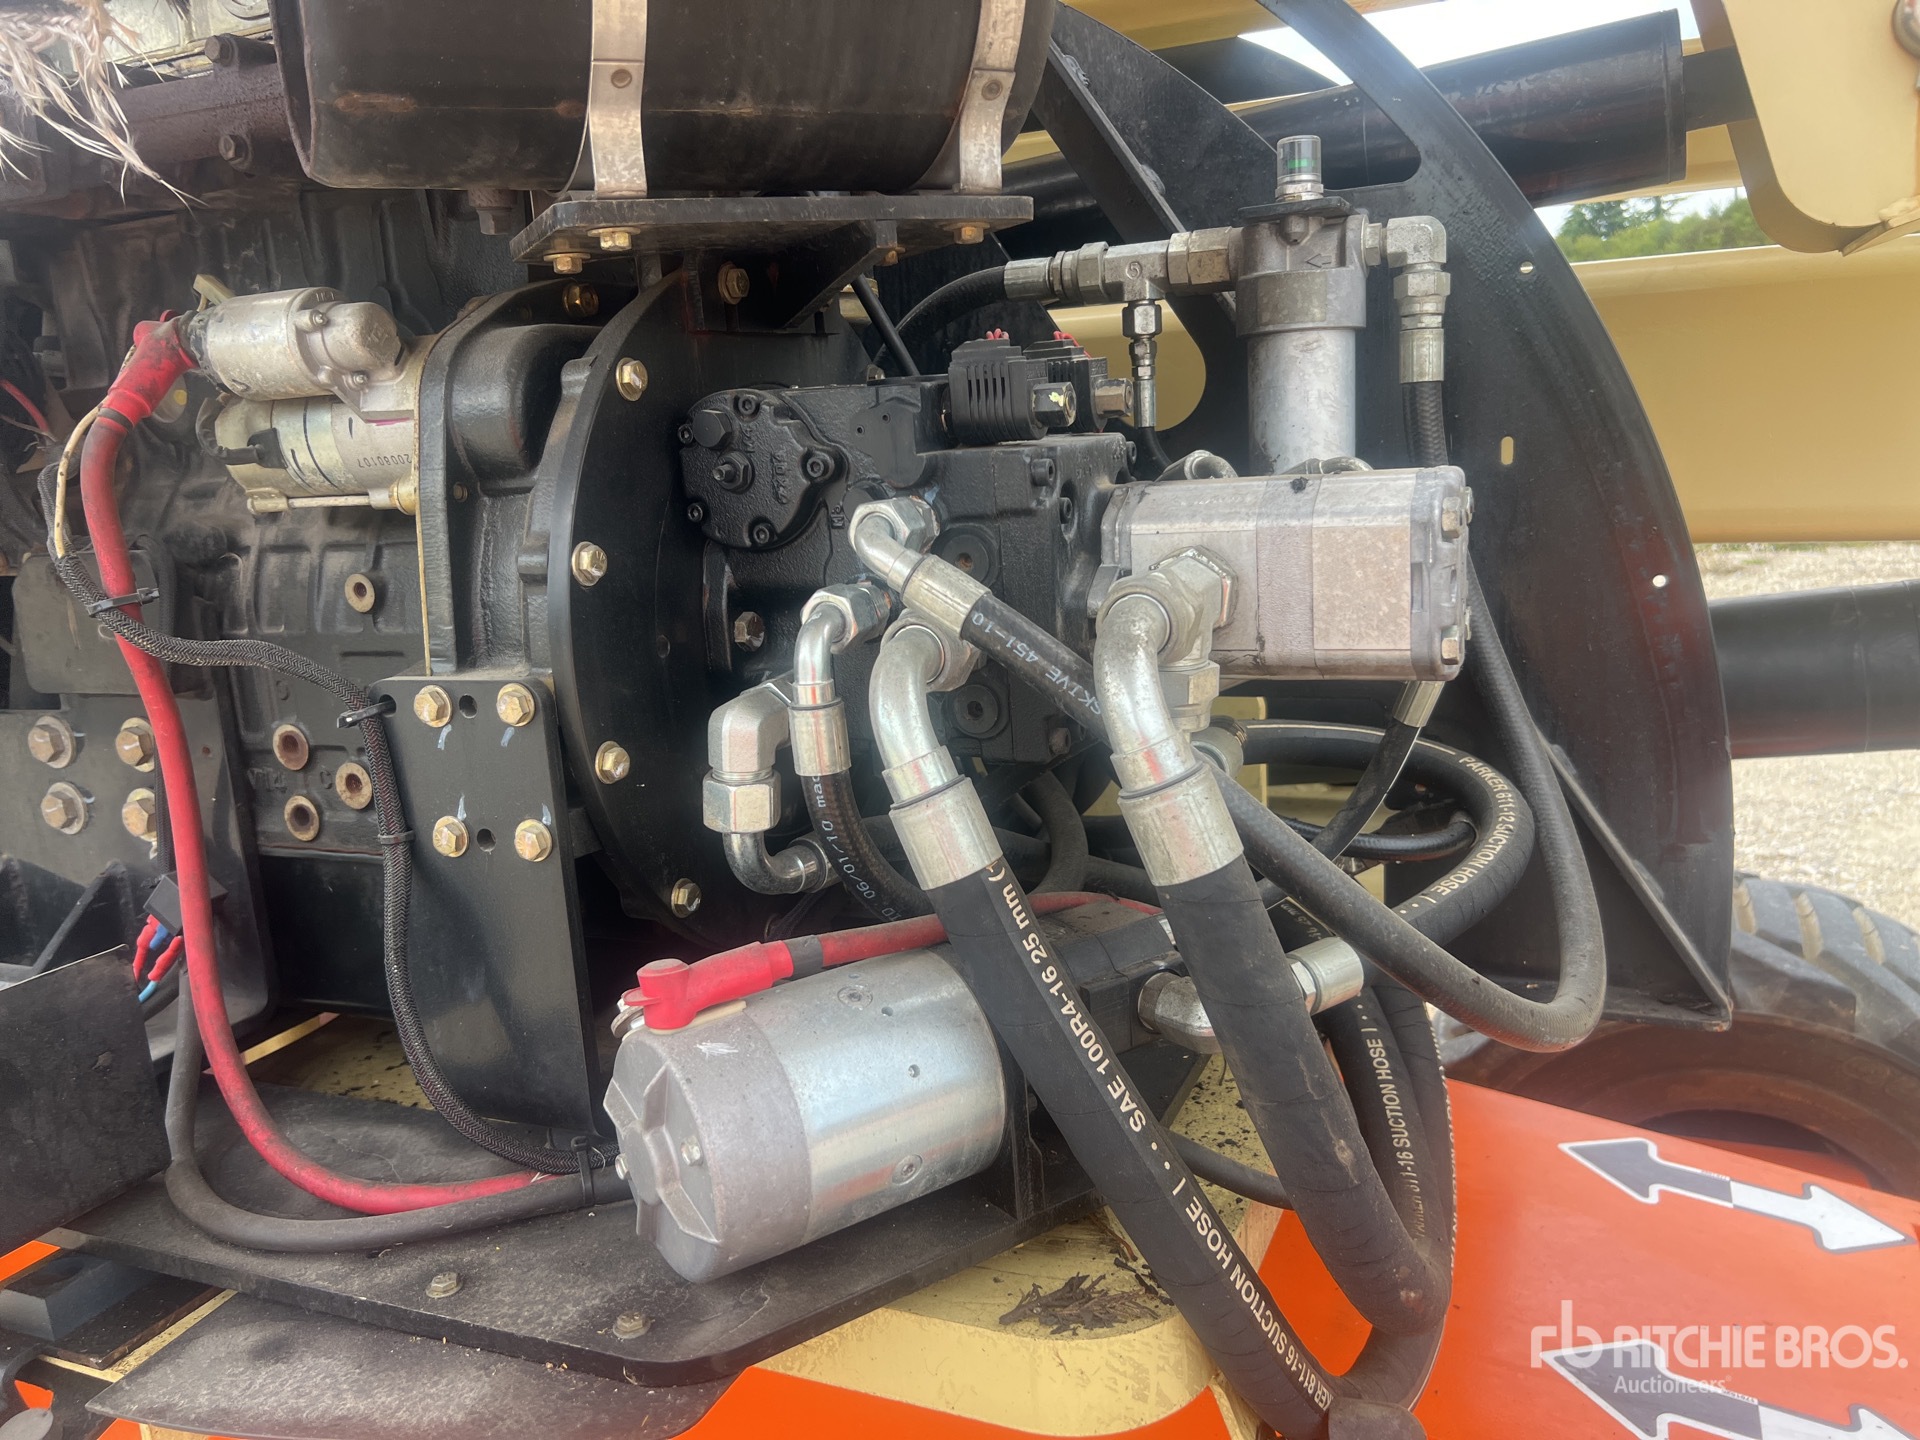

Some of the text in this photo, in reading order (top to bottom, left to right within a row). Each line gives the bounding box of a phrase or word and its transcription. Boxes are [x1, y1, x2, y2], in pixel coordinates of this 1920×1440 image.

[972, 611, 1039, 663] 451-10
[1430, 757, 1516, 896] PARKER 811-12 SUCTION HOSE
[821, 819, 876, 901] 06/01/10
[1002, 883, 1030, 930] mm
[1022, 932, 1048, 964] 25
[1041, 965, 1110, 1075] 100R4-16
[1366, 1038, 1393, 1080] HOSE
[1107, 1074, 1147, 1133] SAE
[1379, 1083, 1411, 1148] SUCTION
[1185, 1196, 1233, 1270] HOSE
[1229, 1263, 1289, 1354] SUCTION
[1285, 1344, 1317, 1394] 811-16
[1314, 1381, 1334, 1411] KER
